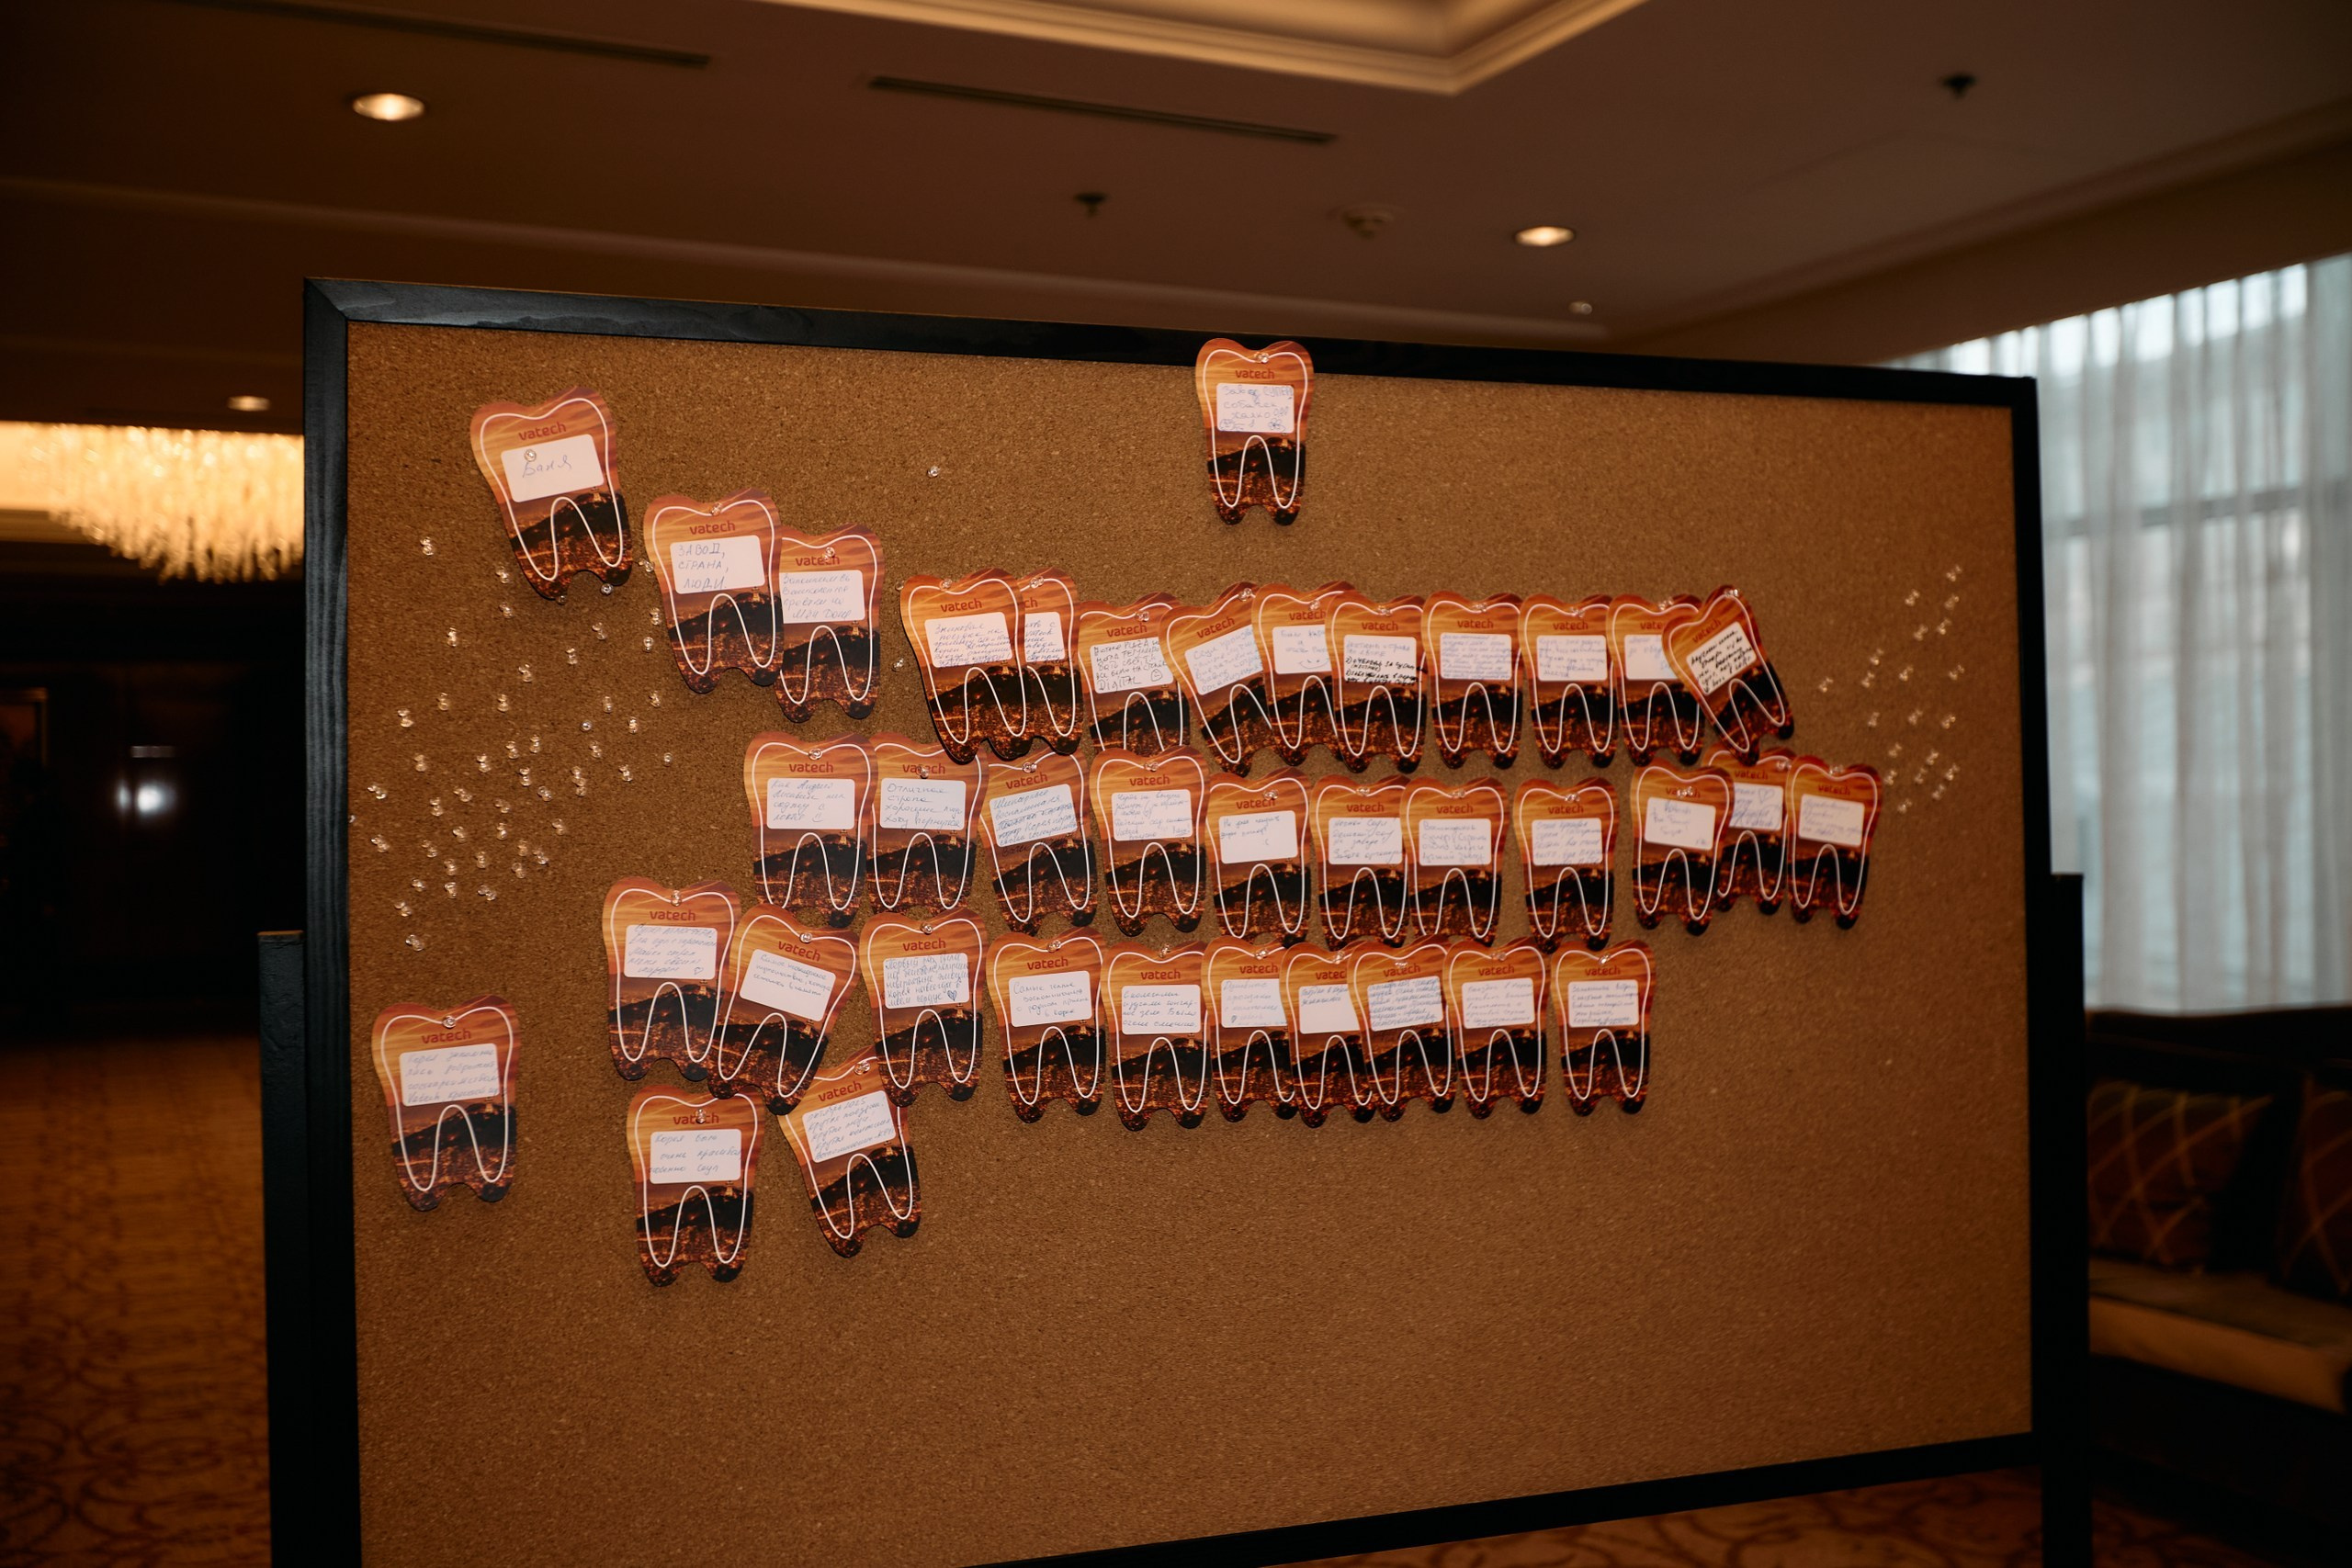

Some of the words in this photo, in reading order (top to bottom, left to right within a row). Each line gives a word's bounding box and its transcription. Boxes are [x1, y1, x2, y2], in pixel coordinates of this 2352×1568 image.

[1235, 367, 1275, 379] vatech
[518, 422, 567, 441] vatech
[689, 520, 736, 535] vatech
[941, 600, 982, 613] vatech
[1196, 617, 1235, 638] vatech
[1362, 621, 1398, 631] vatech
[1457, 618, 1494, 628] vatech
[1553, 620, 1589, 630] vatech
[1640, 621, 1663, 630] vate
[1107, 624, 1148, 637] vatech
[789, 761, 833, 773] vatech
[1005, 772, 1048, 789] vatech
[1129, 774, 1170, 786] vatech
[1346, 801, 1385, 812] vatech
[1436, 804, 1474, 814] vatech
[1548, 804, 1584, 815] vatech
[650, 908, 696, 921] vatech
[902, 938, 946, 952] vatech
[778, 941, 820, 962] vatech
[1027, 957, 1069, 970] vatech
[1239, 963, 1279, 974] vatech
[1140, 969, 1182, 980] vatech
[1315, 970, 1347, 980] vatec
[1384, 964, 1420, 977] vatech
[1478, 964, 1515, 976] vatech
[1585, 965, 1621, 976] vatech
[421, 1029, 471, 1044] vatech
[818, 1080, 862, 1102] vatech
[673, 1112, 720, 1125] vatch
